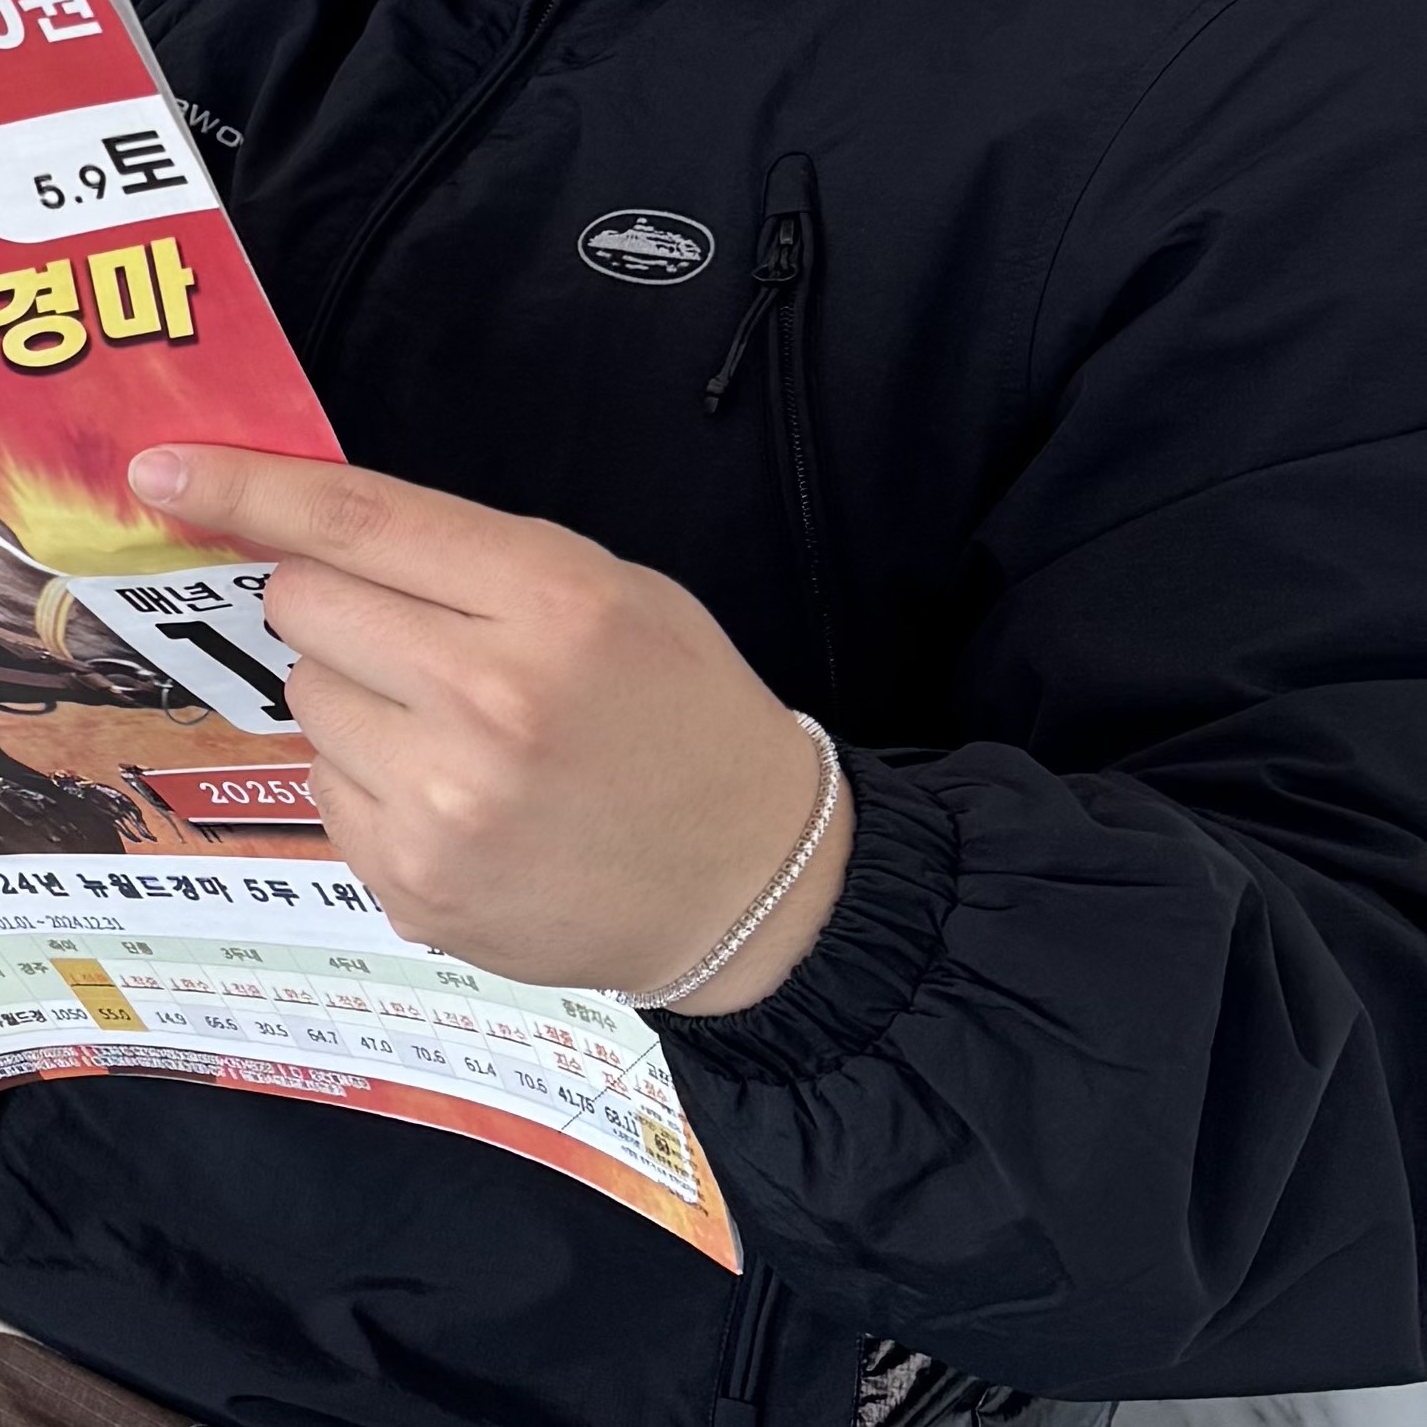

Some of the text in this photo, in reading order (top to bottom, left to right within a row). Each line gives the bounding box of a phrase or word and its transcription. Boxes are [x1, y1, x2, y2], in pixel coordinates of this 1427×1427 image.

[114, 581, 234, 614] 매년
[77, 872, 234, 904] 뉴월드경마
[243, 877, 299, 907] 5두
[16, 962, 50, 976] 경주
[50, 1008, 89, 1021] 1050
